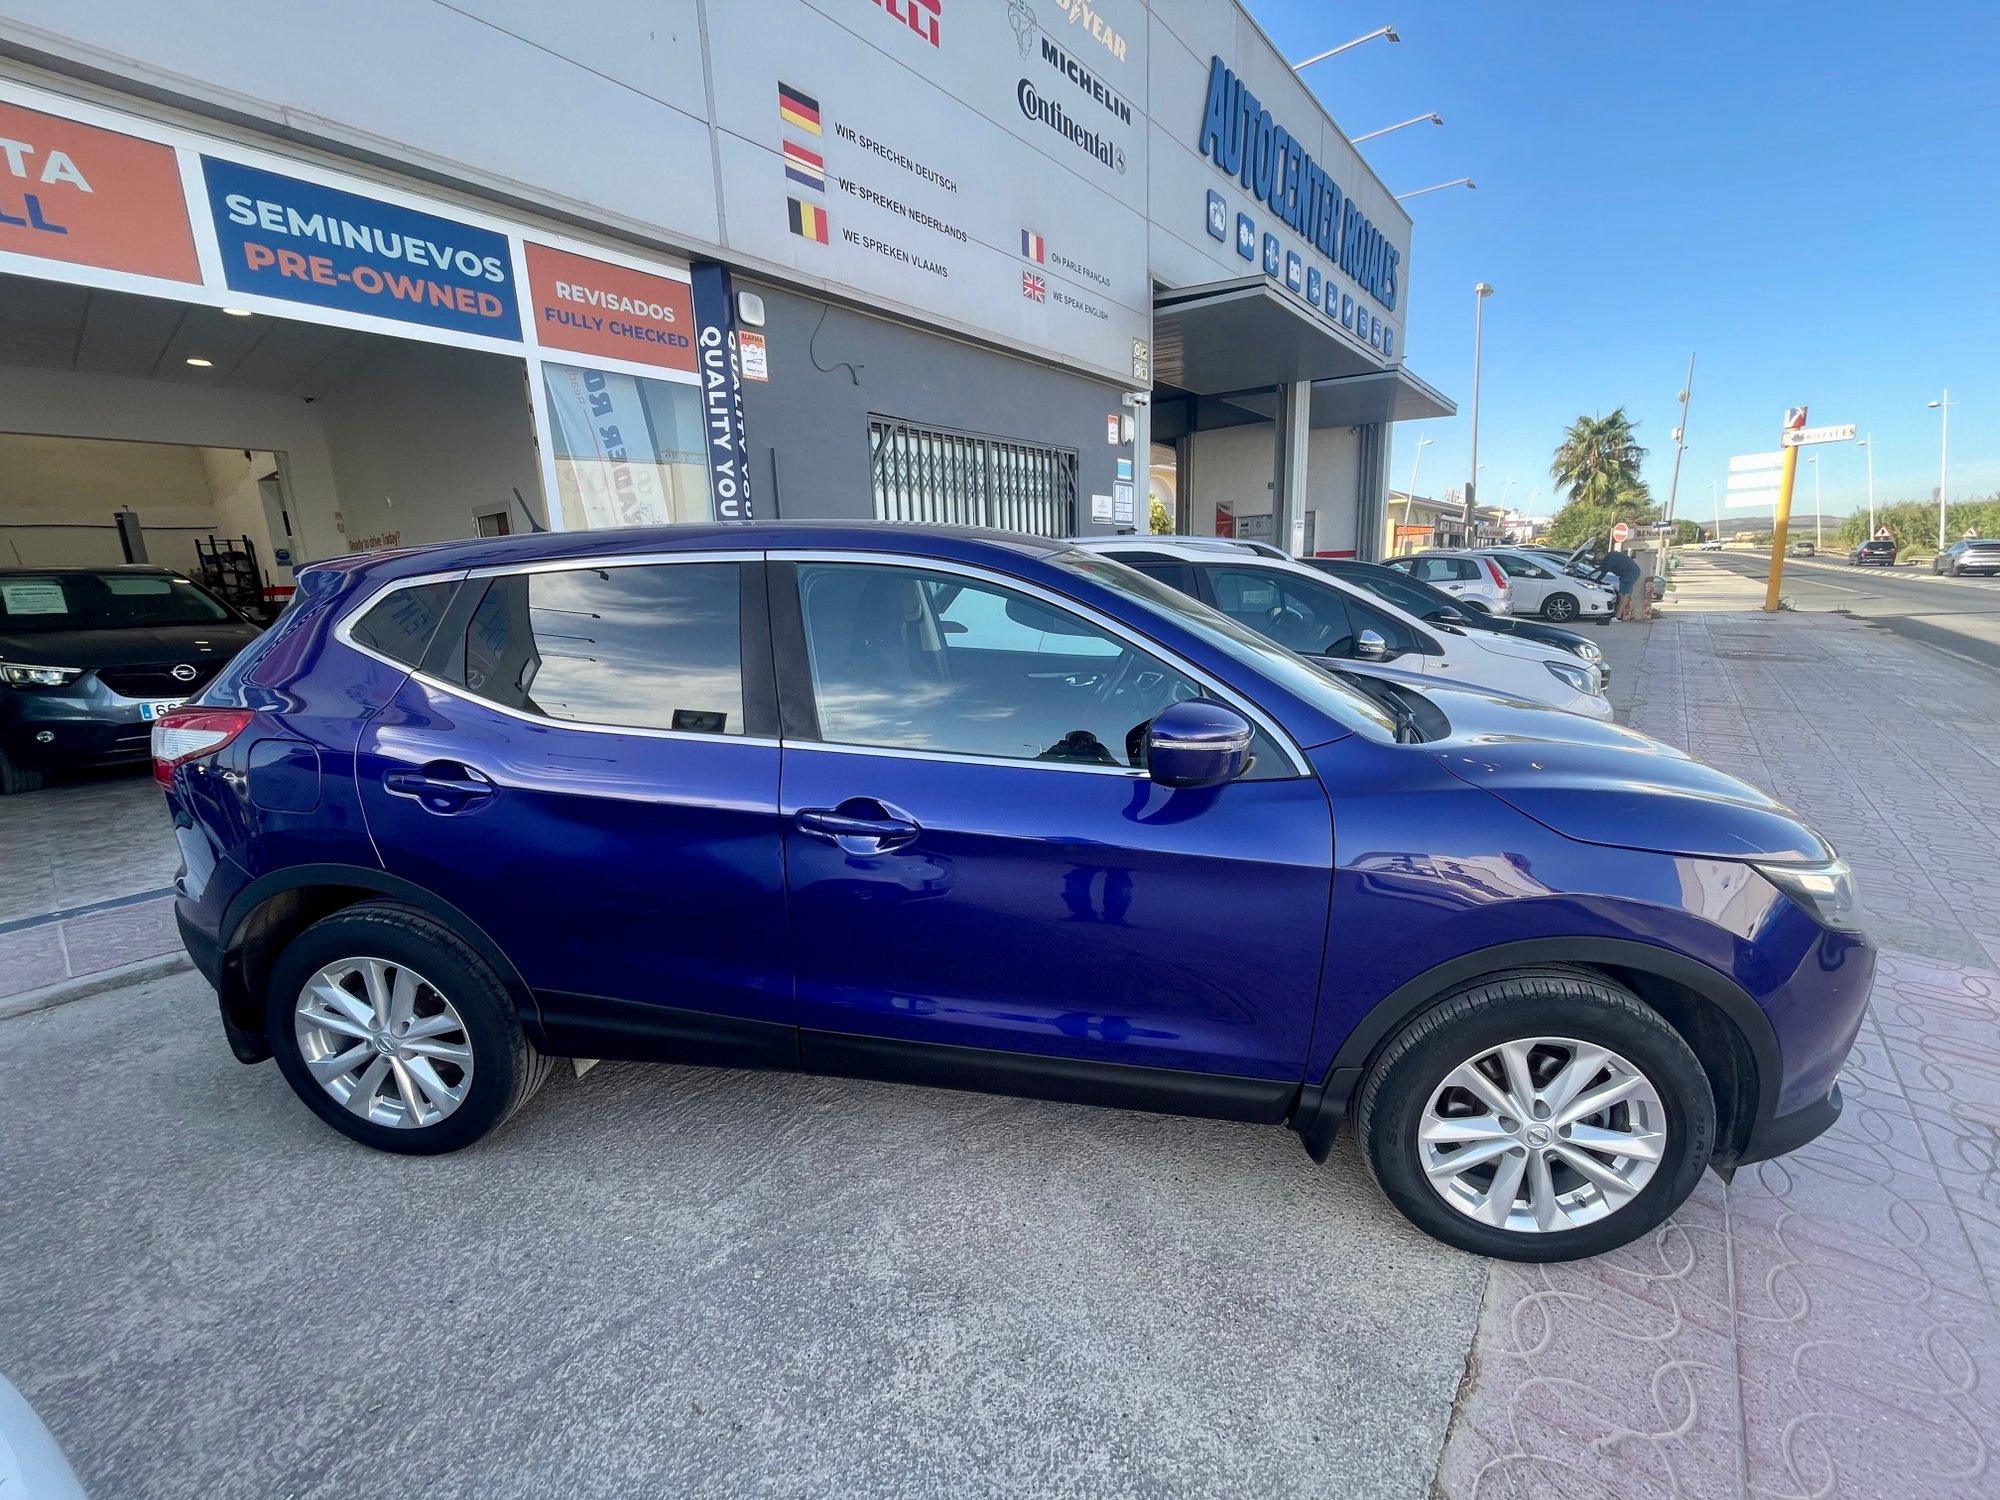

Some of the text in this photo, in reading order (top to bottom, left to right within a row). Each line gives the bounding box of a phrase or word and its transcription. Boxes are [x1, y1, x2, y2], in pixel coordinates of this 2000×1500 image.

[1041, 36, 1131, 126] MICHELIN
[834, 121, 958, 194] WIR SPRECHEN DEUTSCH
[1017, 78, 1115, 169] Continental
[838, 176, 968, 243] WE SPREKEN NEDERLANDS
[1200, 54, 1400, 312] AUTOCENTER ROJALES
[225, 194, 505, 283] SEMINUEVOS
[842, 228, 948, 278] WE SPREKEN VLAAMS
[1051, 253, 1111, 287] ON PARLE FRANÇAIS
[243, 241, 503, 318] PRE-OWNED
[555, 281, 676, 323] REVISADOS
[1052, 291, 1109, 321] WE SPEAK ENGLISH
[544, 307, 689, 348] FULLY CHECKED
[741, 333, 763, 343] ALARMA
[700, 326, 739, 517] QUALITY YOU
[727, 330, 747, 455] QUALITY
